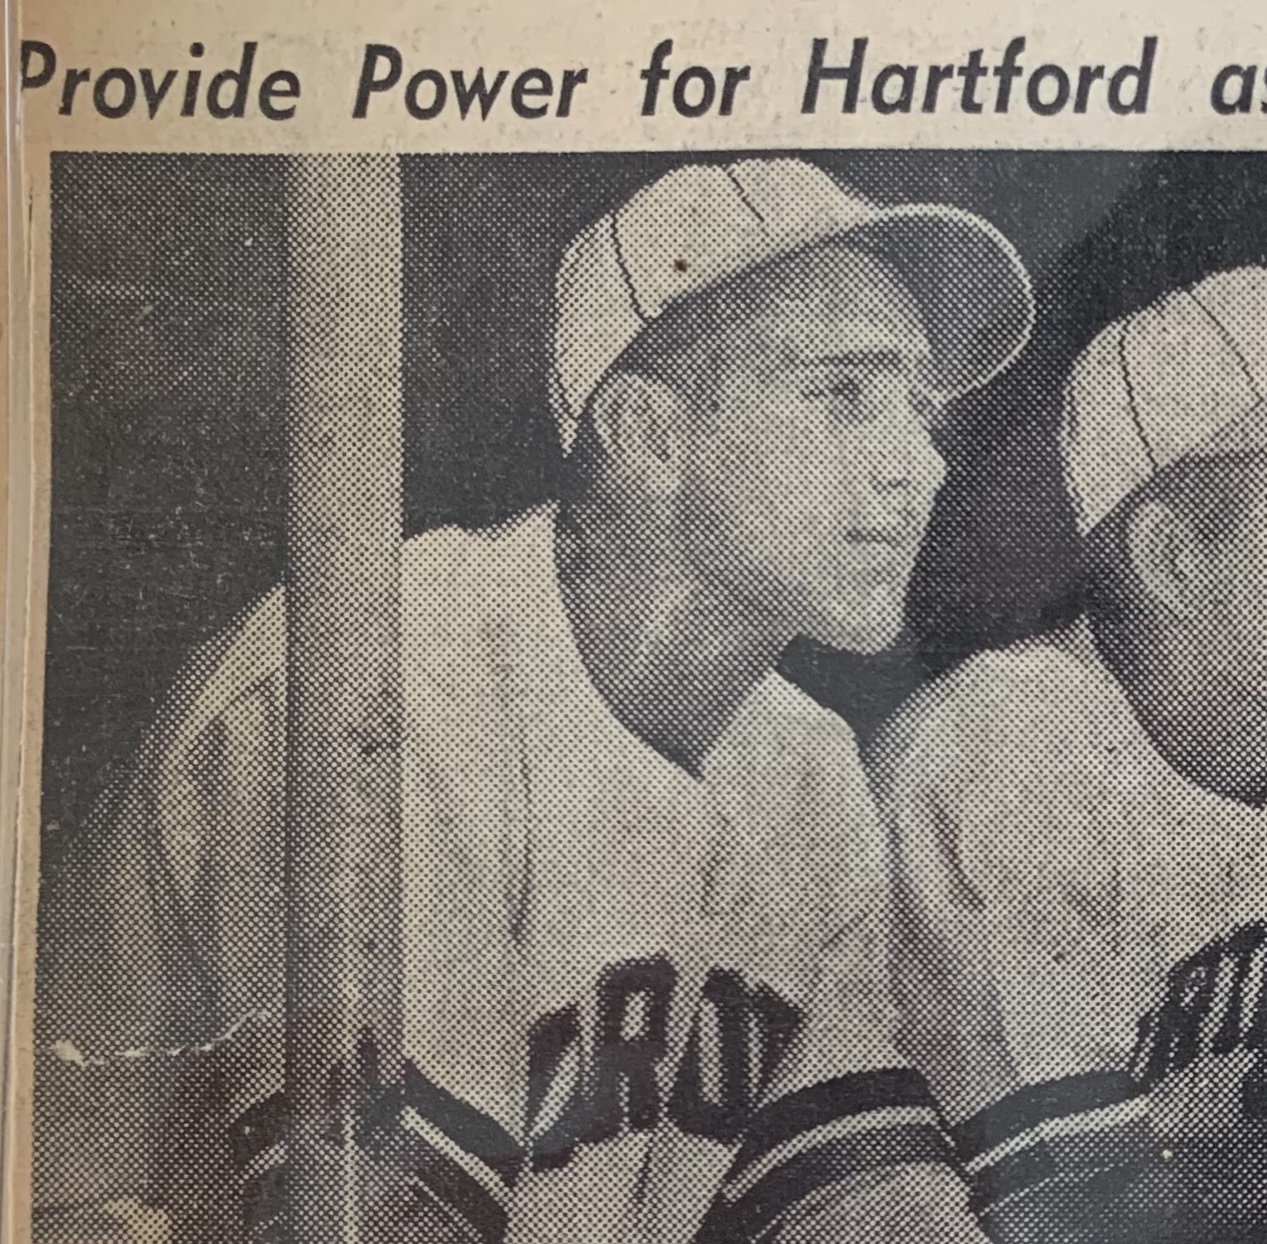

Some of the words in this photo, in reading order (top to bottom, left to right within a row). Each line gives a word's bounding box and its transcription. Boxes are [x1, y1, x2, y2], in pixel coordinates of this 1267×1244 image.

[20, 39, 301, 121] Provide
[351, 43, 589, 122] Power
[640, 38, 752, 118] for
[800, 35, 1158, 116] Hartford
